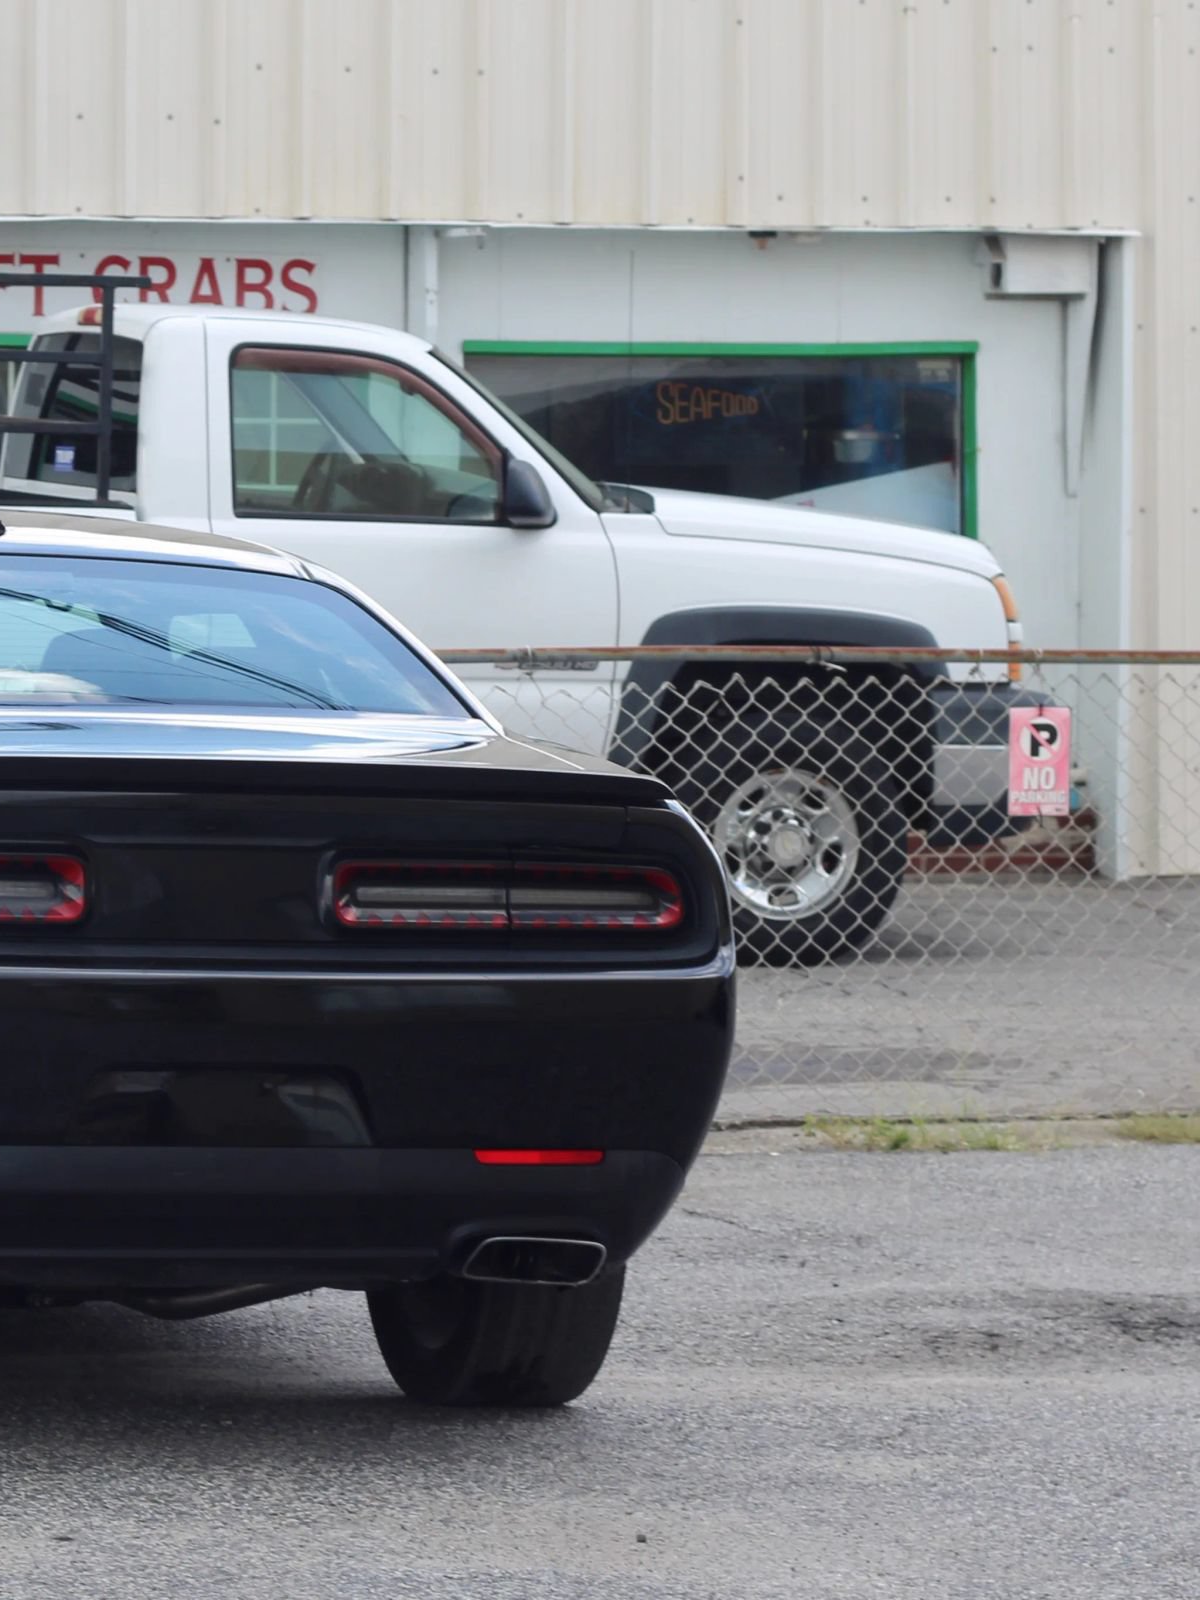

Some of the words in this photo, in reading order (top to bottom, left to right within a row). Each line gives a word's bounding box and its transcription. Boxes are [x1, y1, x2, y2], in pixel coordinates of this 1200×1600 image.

[94, 255, 318, 314] CRABS
[657, 381, 759, 424] SEAFOOD
[1023, 767, 1056, 790] NO
[1010, 791, 1066, 804] PARKING
